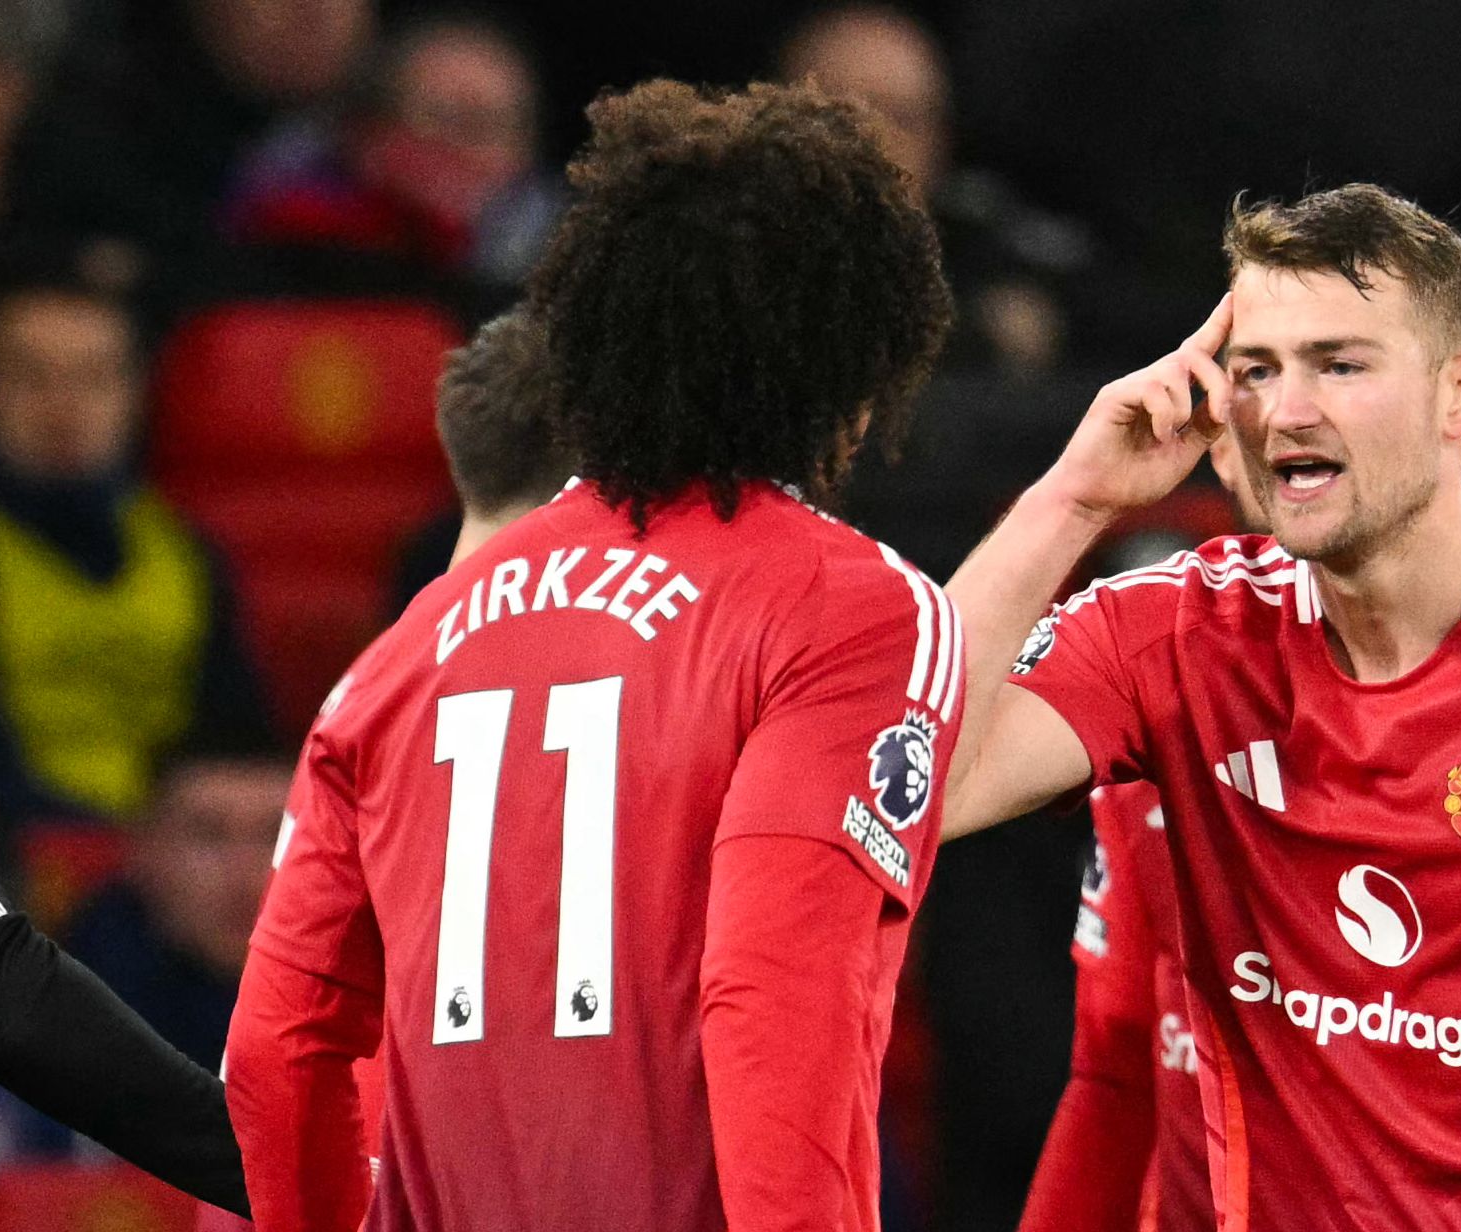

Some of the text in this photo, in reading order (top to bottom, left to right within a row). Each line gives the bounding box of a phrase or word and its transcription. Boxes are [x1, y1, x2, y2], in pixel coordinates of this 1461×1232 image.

[435, 546, 700, 665] ZIRKZEE
[432, 676, 624, 1046] 11
[845, 794, 872, 829] No
